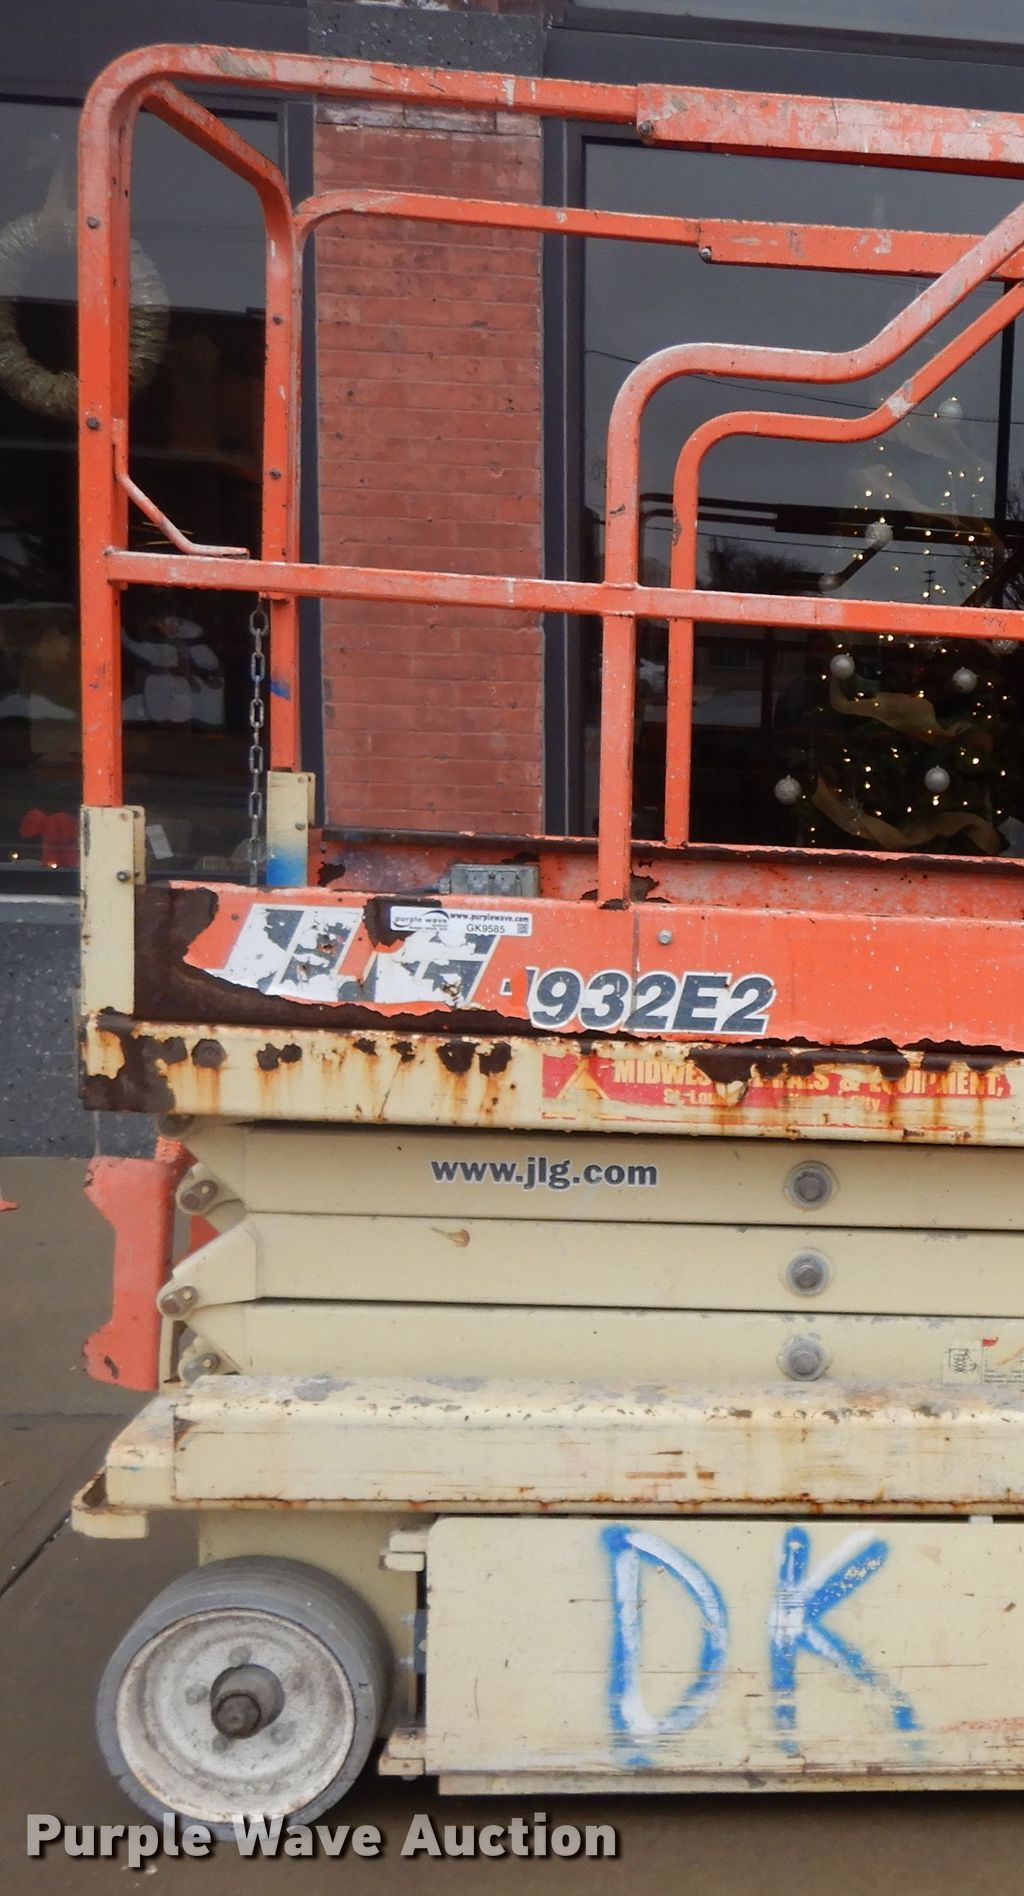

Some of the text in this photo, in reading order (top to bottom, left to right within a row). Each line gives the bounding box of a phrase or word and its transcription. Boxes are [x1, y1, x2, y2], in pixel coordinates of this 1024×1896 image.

[450, 913, 529, 923] www.purplewave.com
[466, 923, 506, 934] GK9585
[430, 1156, 659, 1191] www.jlg.com
